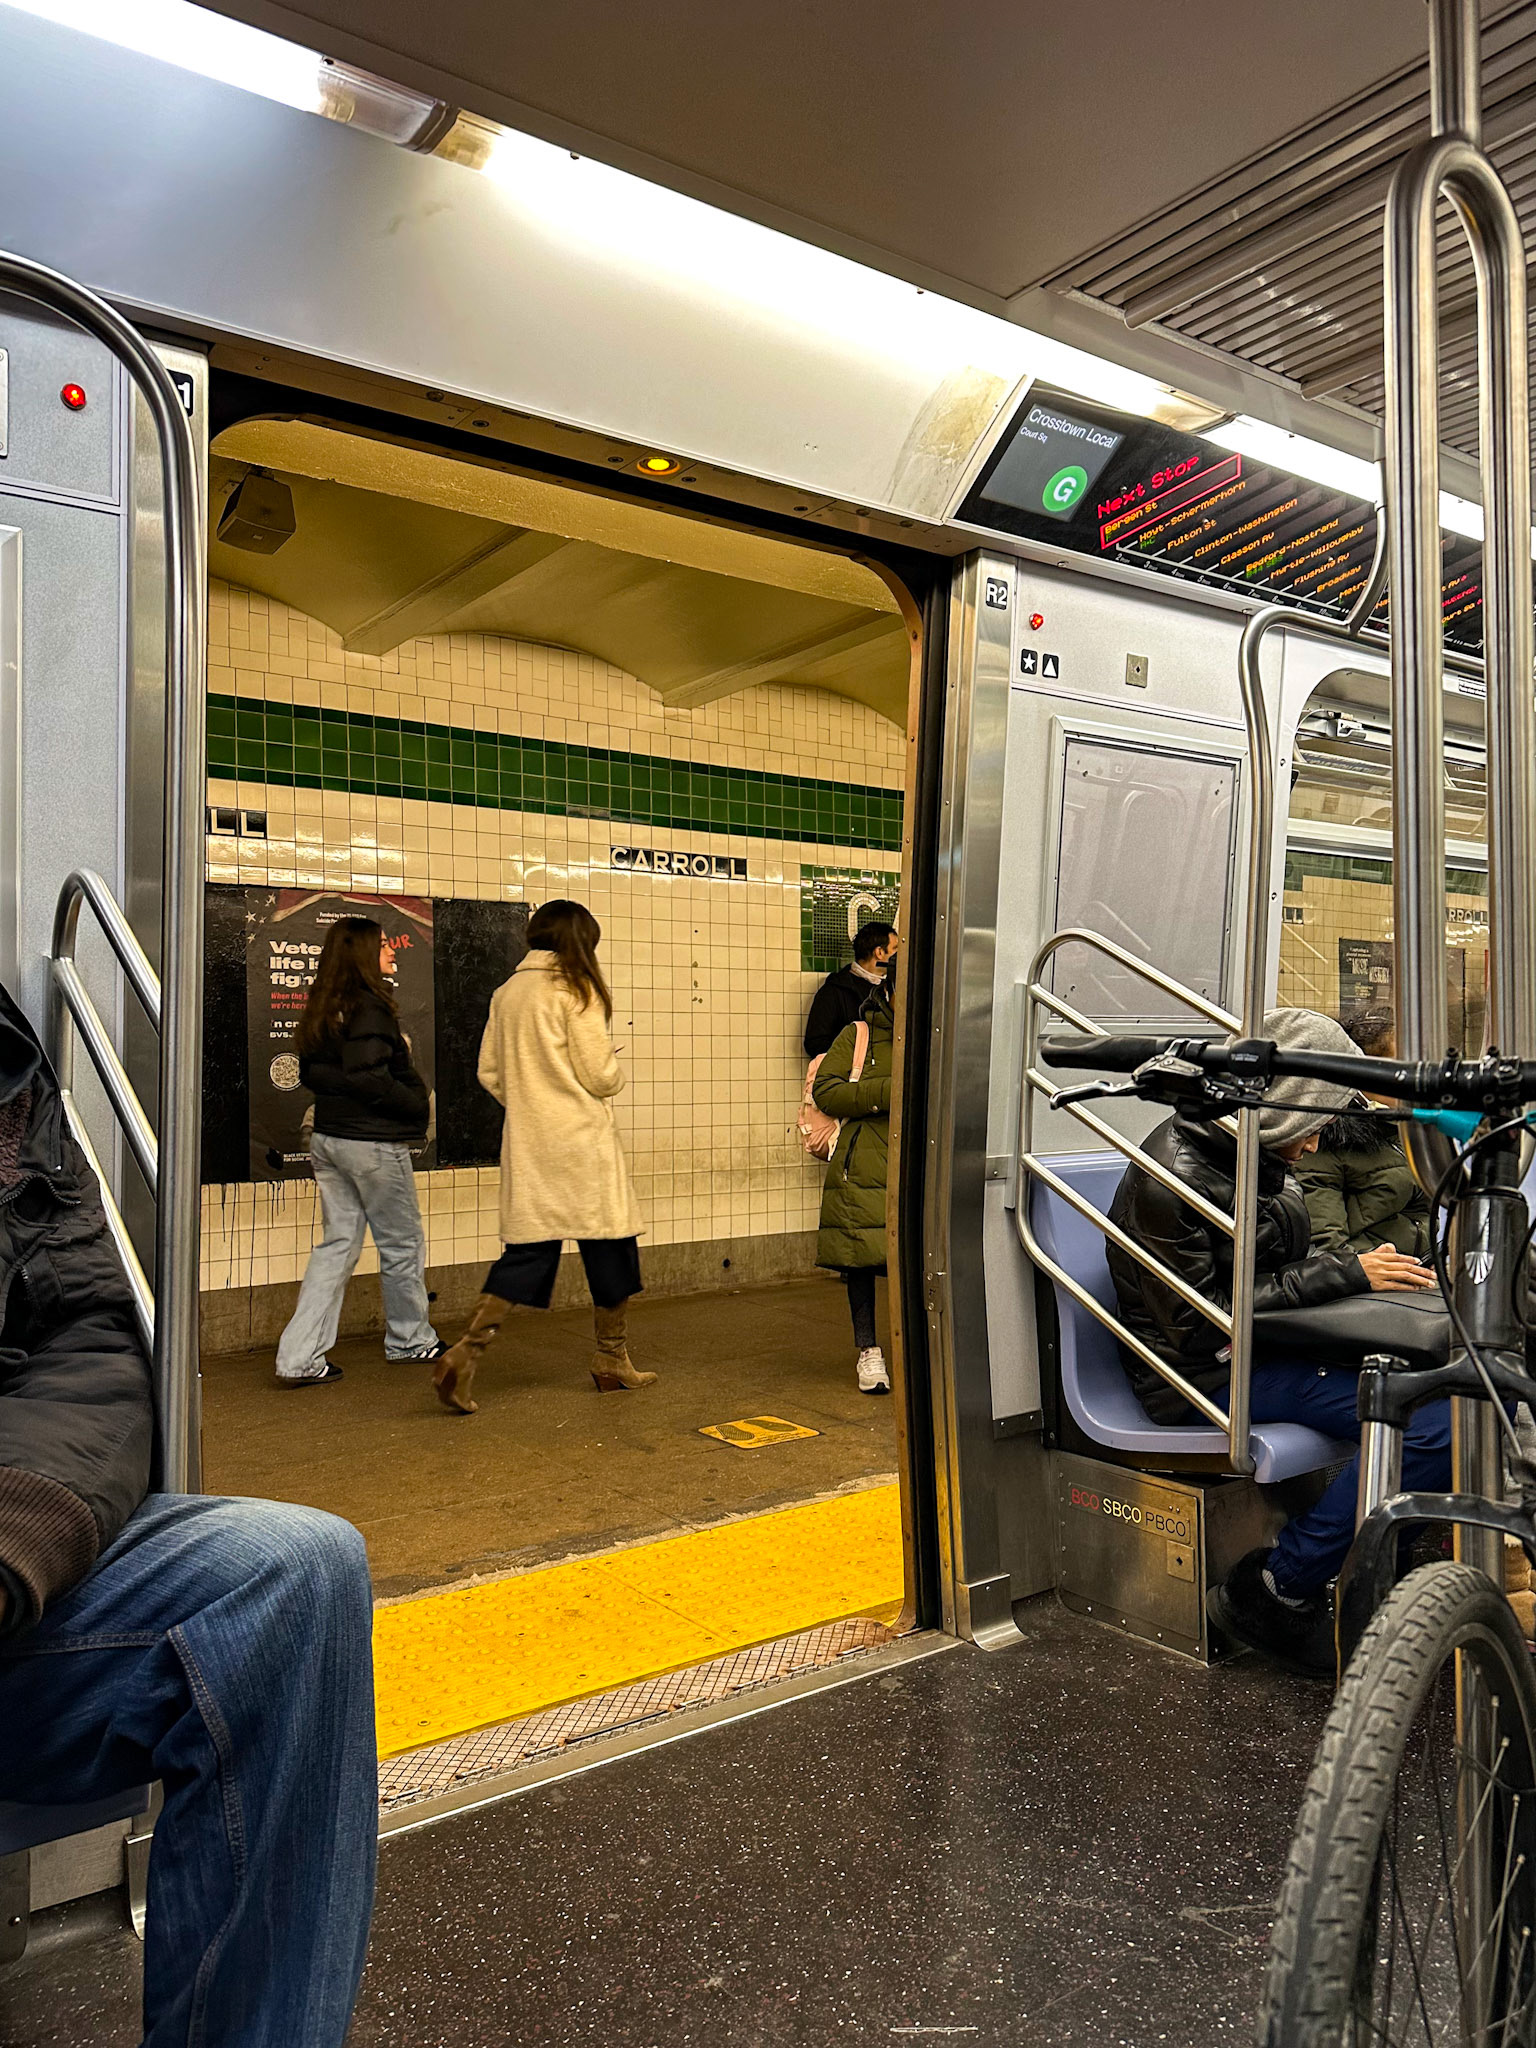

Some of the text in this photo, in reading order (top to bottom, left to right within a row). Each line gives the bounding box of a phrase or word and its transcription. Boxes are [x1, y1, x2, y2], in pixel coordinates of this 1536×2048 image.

[1020, 426, 1048, 444] Court Sq
[1029, 409, 1118, 449] Crosstown Local
[1053, 476, 1077, 503] G
[1097, 482, 1146, 519] Next
[1104, 510, 1144, 535] Bergen
[1138, 480, 1246, 543] Hoyt-Schermerhorn
[1167, 526, 1203, 550] Fulton
[1194, 498, 1298, 557] Clinton-Washington
[1220, 539, 1260, 565] Classon
[1245, 518, 1339, 572] Bedford-Nostrand
[1270, 525, 1364, 579] Myrtle-Willoughby
[1294, 559, 1336, 586] Flushing
[1316, 565, 1362, 593] Broadway
[986, 582, 1007, 605] R2
[211, 808, 265, 838] LL
[611, 847, 746, 879] CARROLL
[269, 940, 324, 956] Vete
[269, 956, 305, 970] life
[271, 991, 290, 1000] When
[1071, 1488, 1186, 1537] BCO SBCO PBCO
